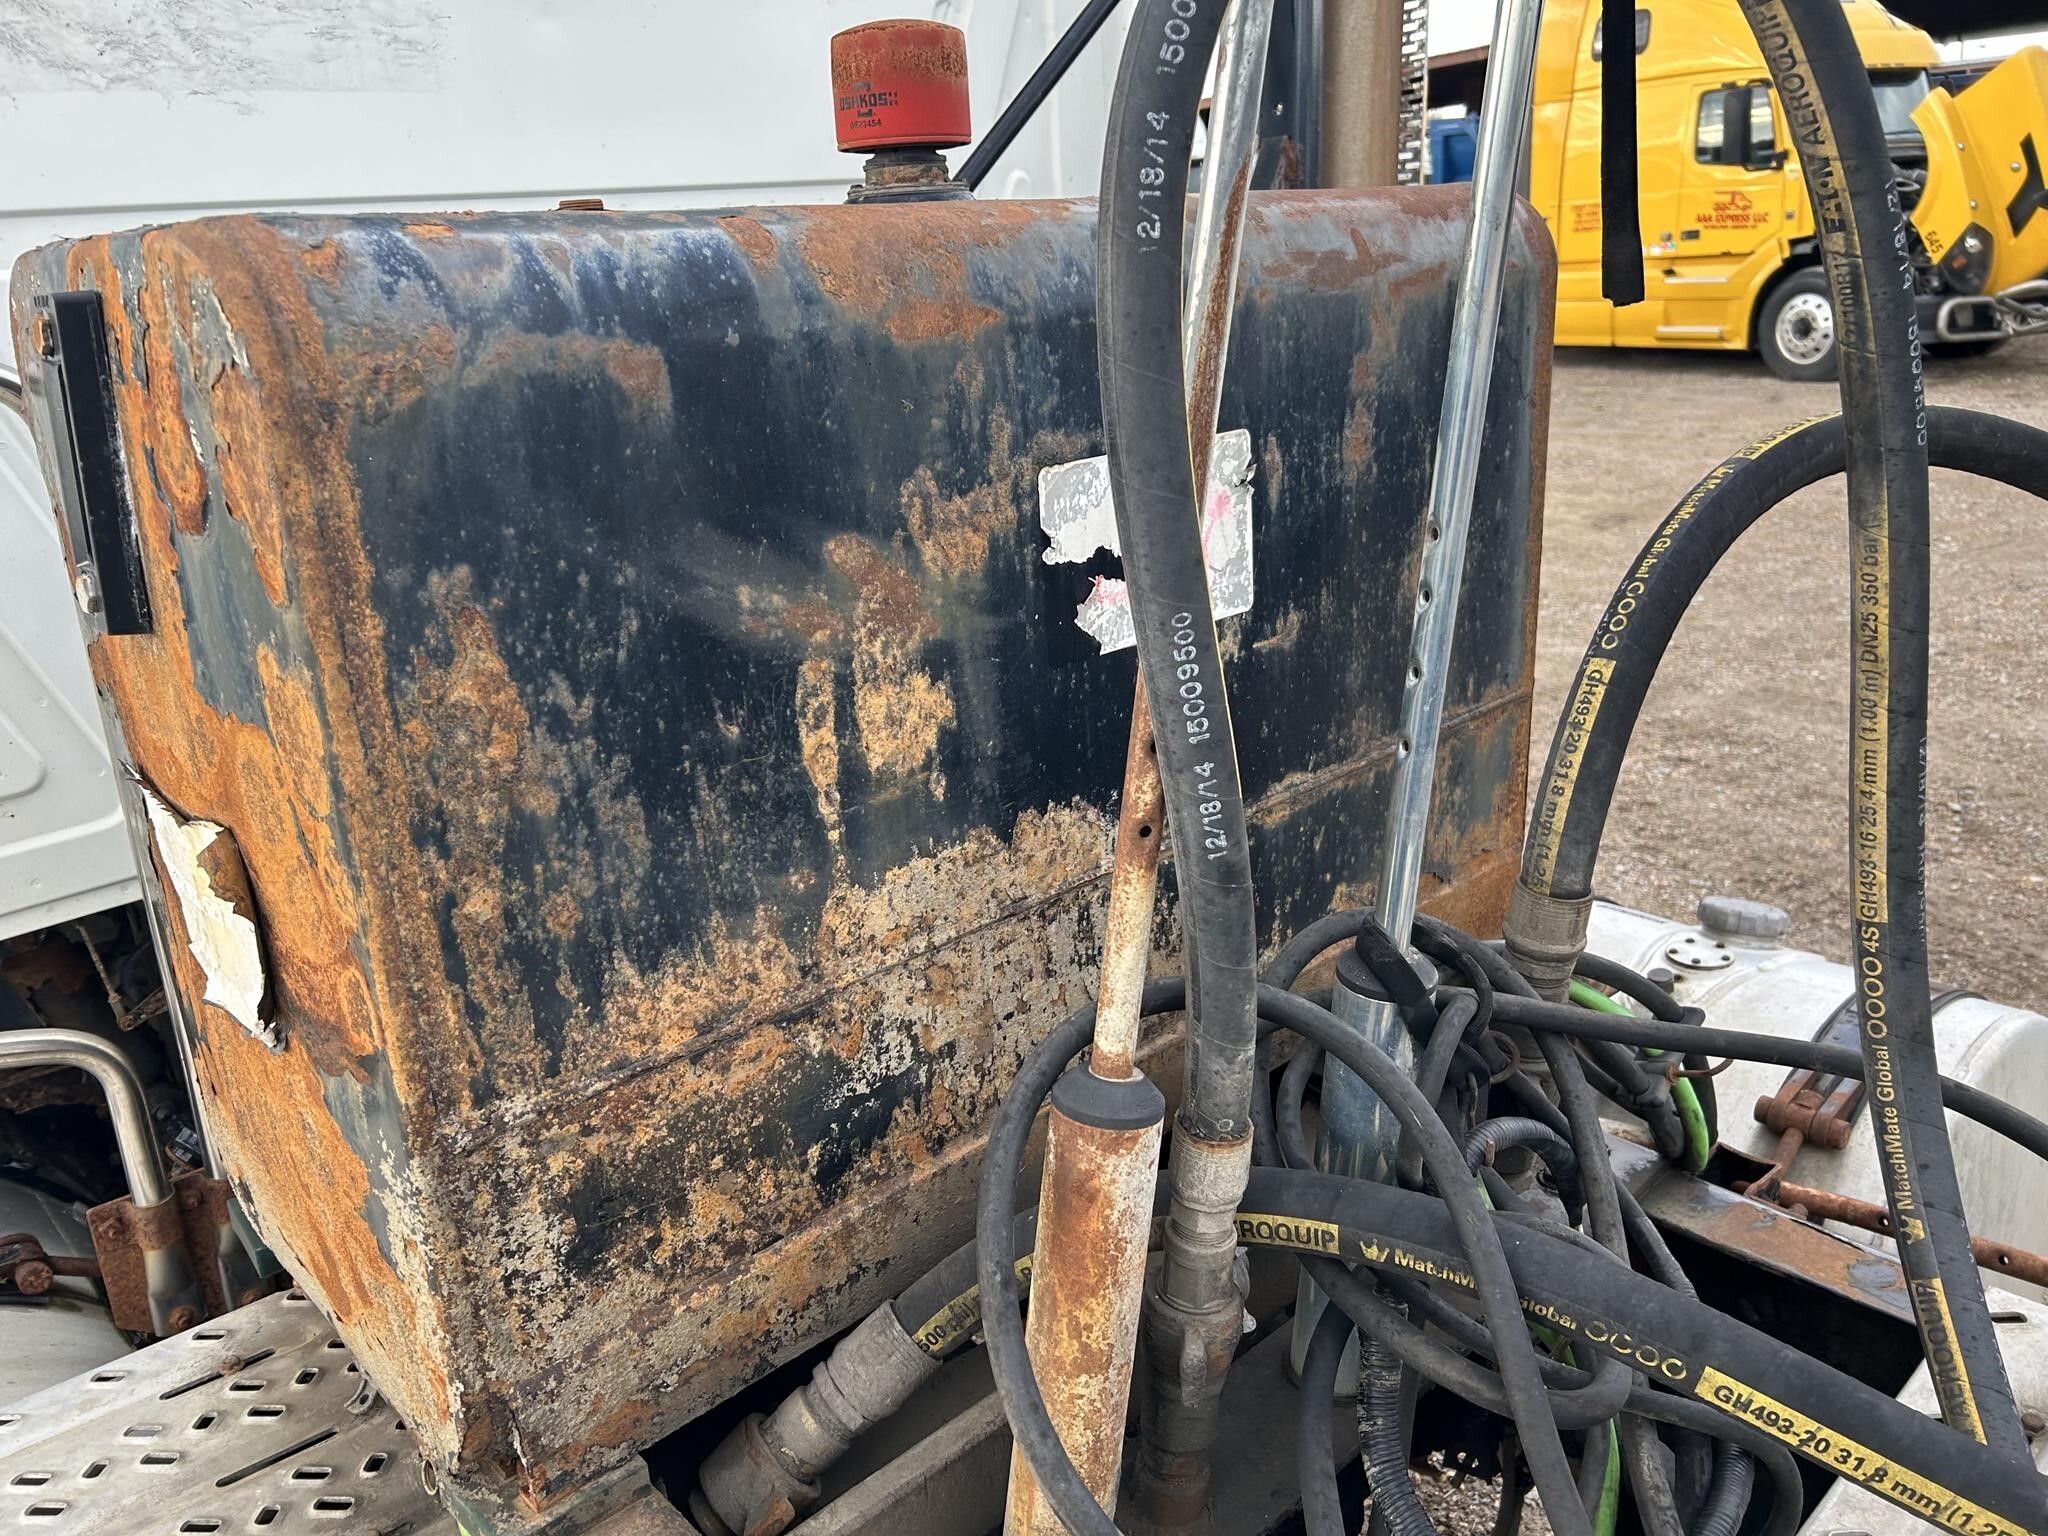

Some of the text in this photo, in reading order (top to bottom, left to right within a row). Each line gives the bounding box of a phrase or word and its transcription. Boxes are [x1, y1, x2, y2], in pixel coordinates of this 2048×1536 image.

[1758, 12, 1826, 146] AEROQUIP
[1860, 572, 1879, 608] 350
[1860, 612, 1879, 664] DN25
[1171, 612, 1228, 862] 12/18/14 15009500
[1551, 757, 1573, 797] 31.8
[1862, 749, 1878, 786] mm
[1859, 788, 1877, 828] 25.4
[1859, 832, 1878, 921] GH493-16
[1861, 926, 1880, 953] 4S
[1872, 1044, 1895, 1103] Global
[1881, 1107, 1915, 1211] MatchMate
[1713, 1384, 1829, 1455] GH493-20
[1833, 1448, 1889, 1484] 31.8
[1890, 1480, 1942, 1514] mm
